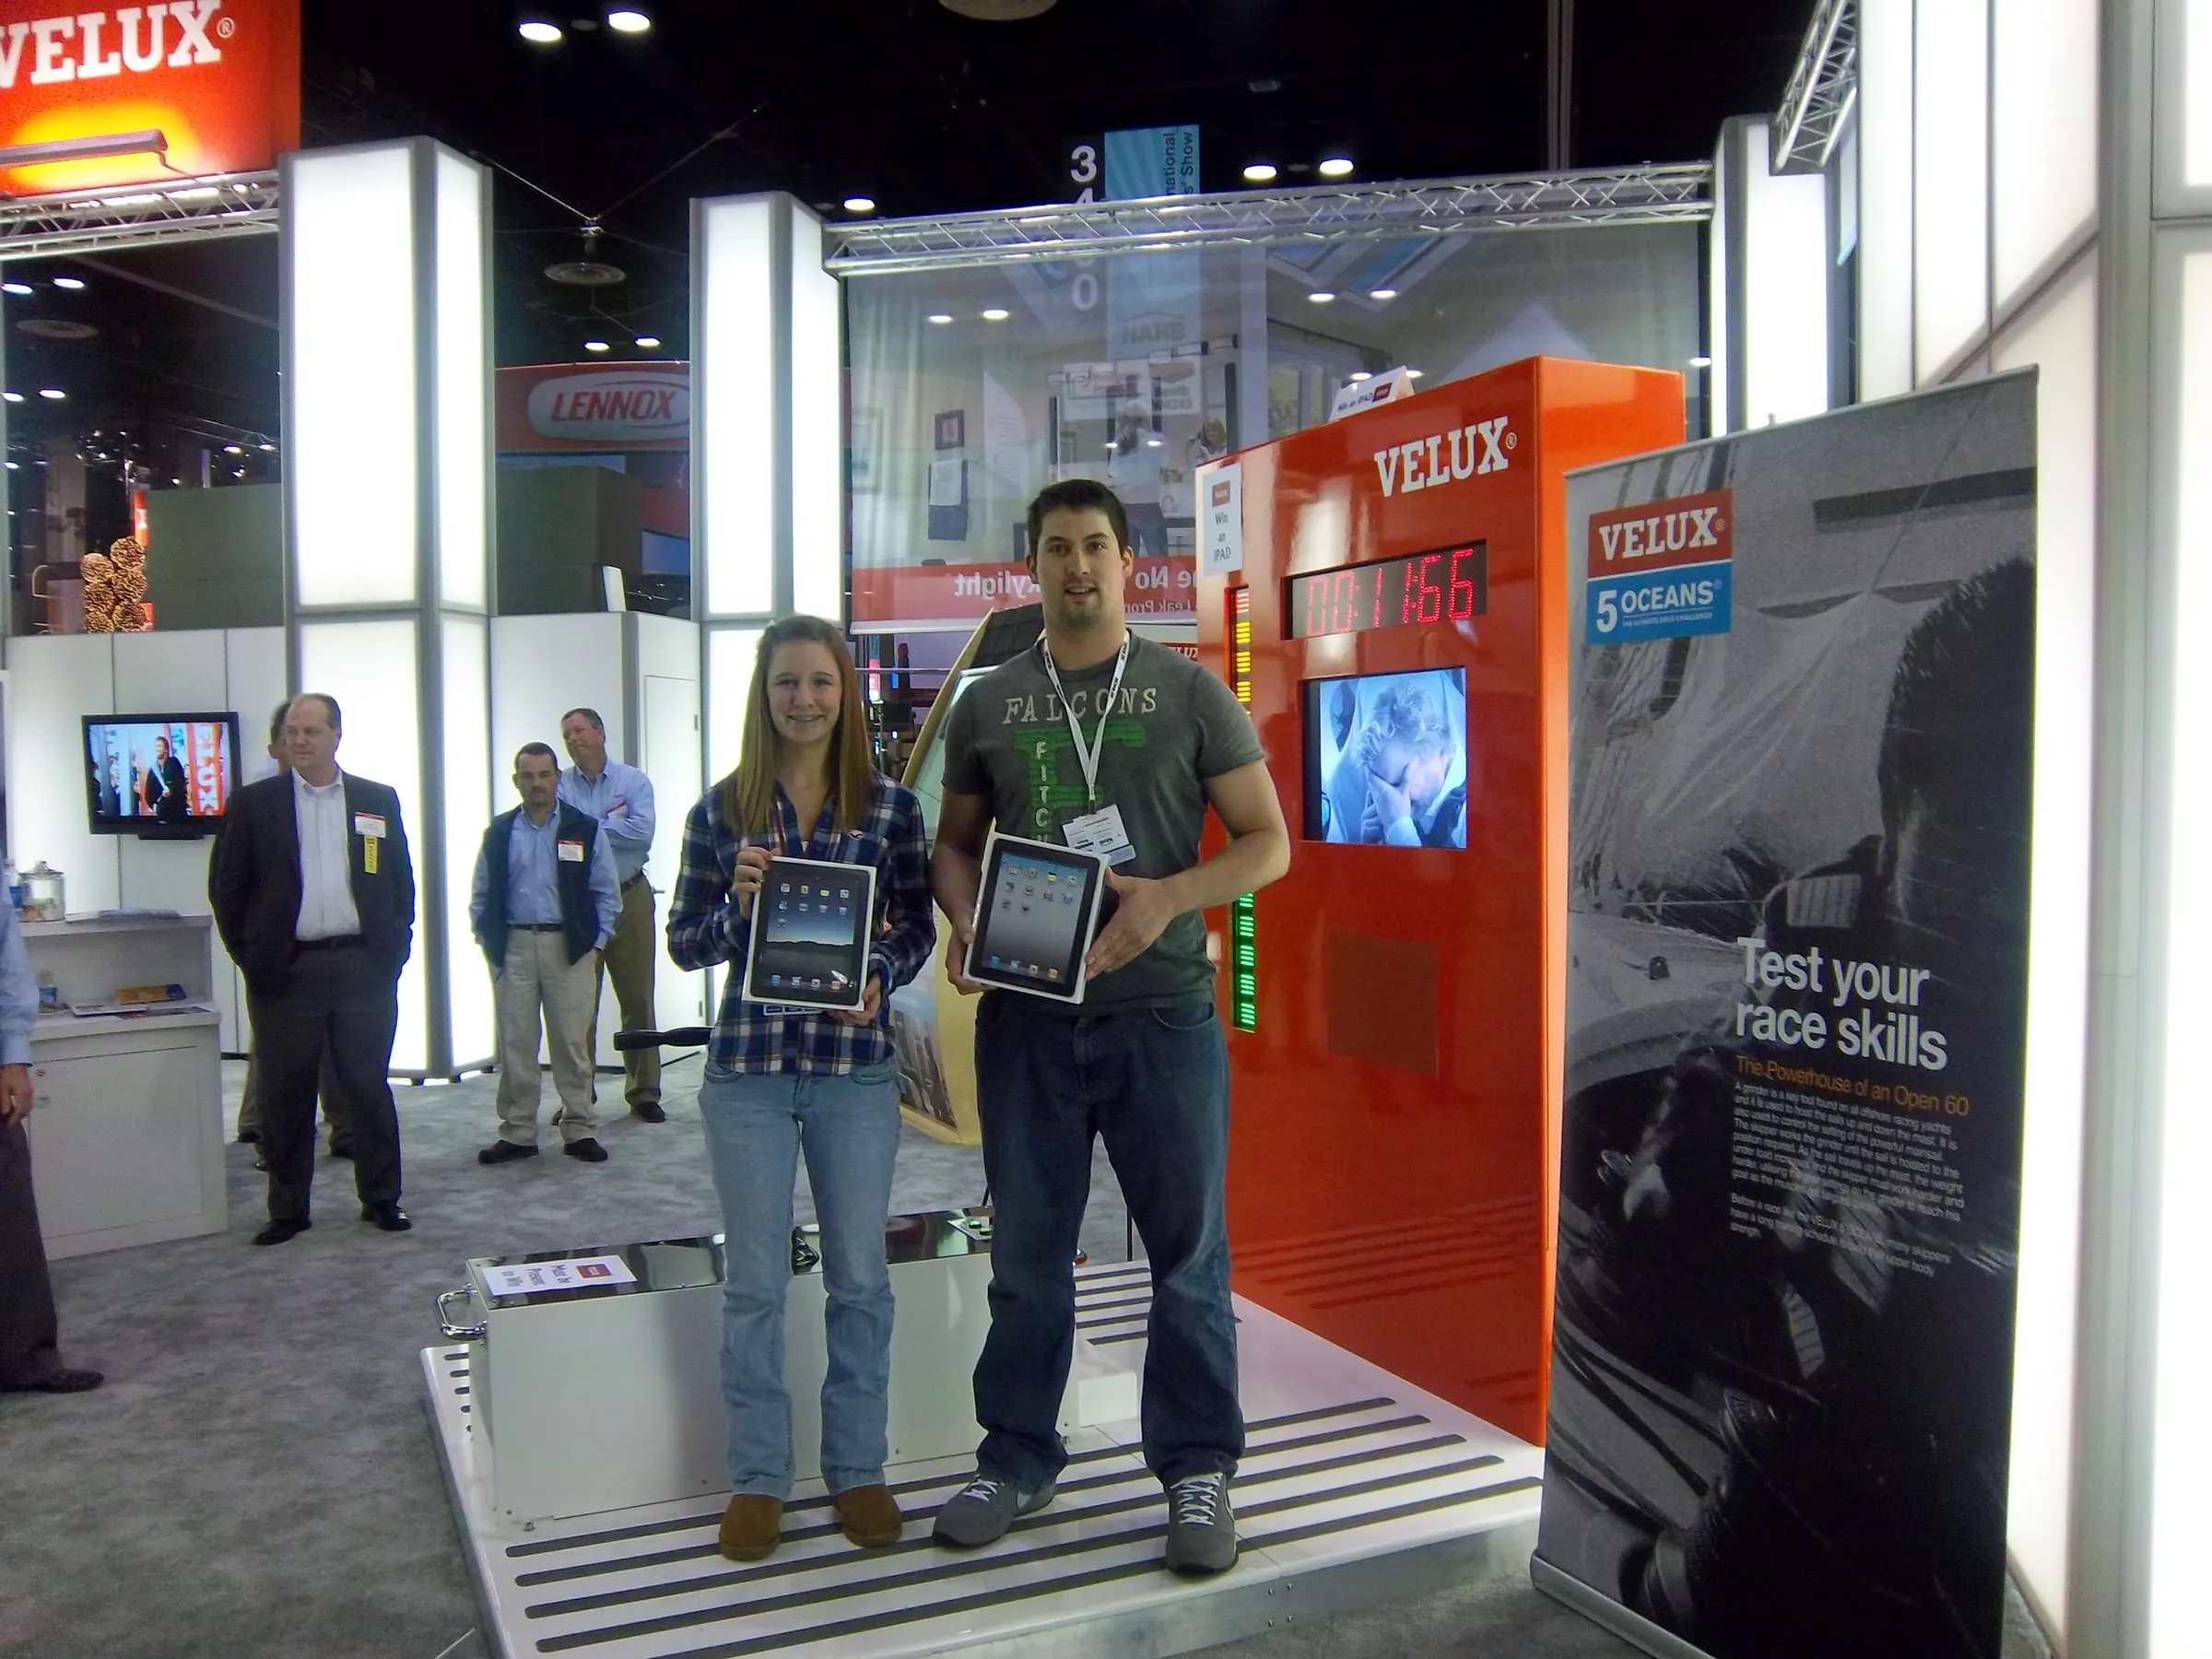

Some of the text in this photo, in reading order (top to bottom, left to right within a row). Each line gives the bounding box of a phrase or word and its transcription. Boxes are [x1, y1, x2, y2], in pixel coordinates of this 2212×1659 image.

[1162, 133, 1176, 194] national
[1181, 133, 1194, 176] Show
[550, 390, 677, 422] LENNOX
[1215, 512, 1229, 524] Win
[1218, 533, 1226, 542] an
[1596, 590, 1618, 633] 5
[1002, 688, 1157, 724] FALCONS
[1737, 936, 1930, 1008] Test your
[1735, 1002, 1947, 1071] race skills
[1736, 1055, 1969, 1118] The Powerhouse of an Open 60
